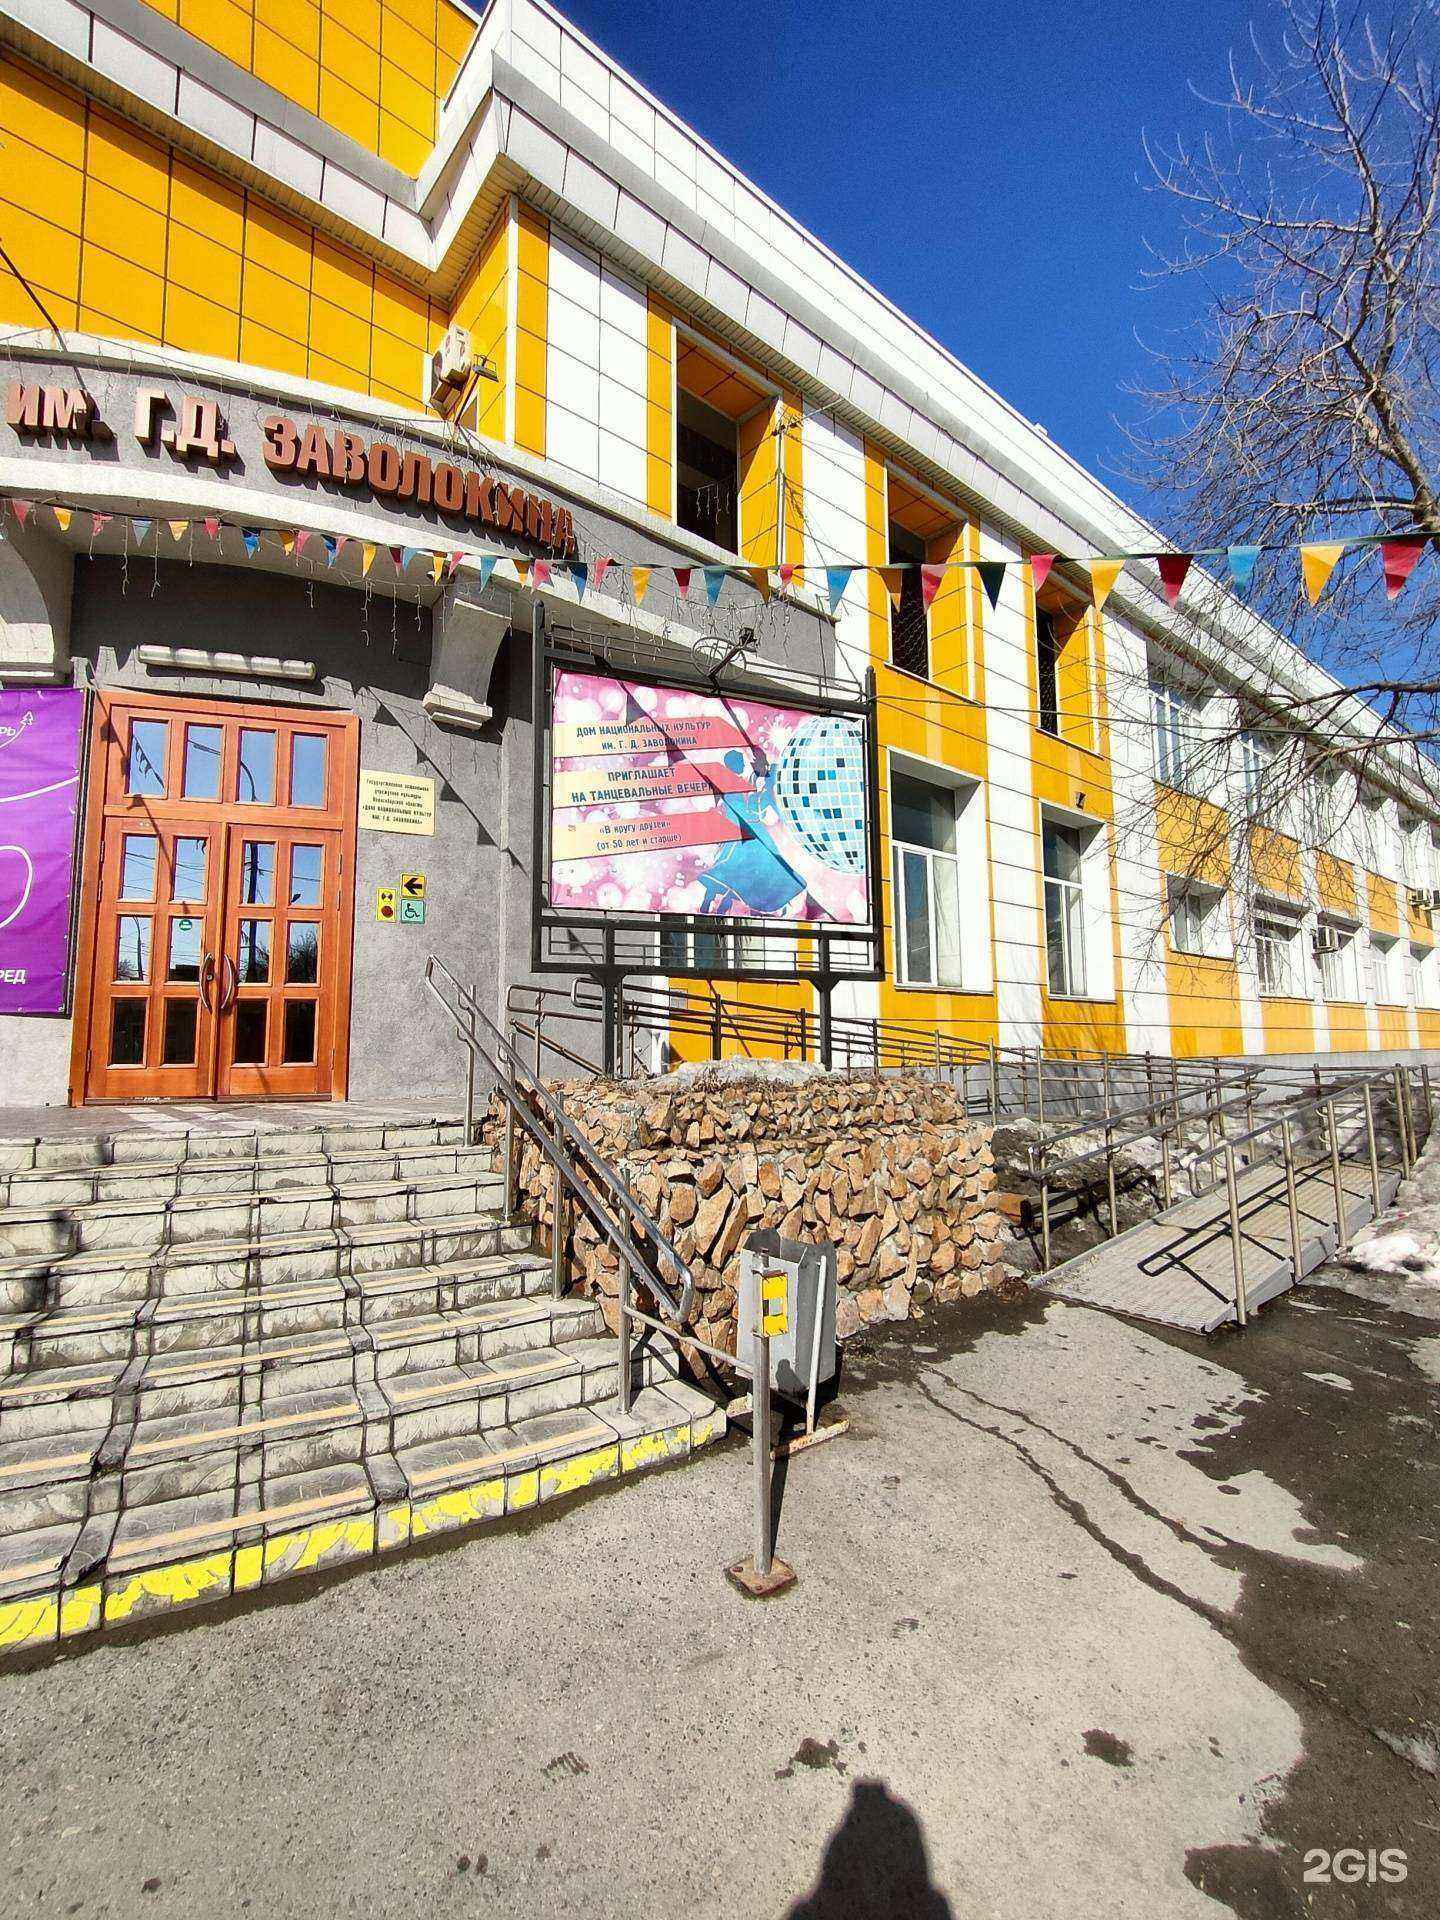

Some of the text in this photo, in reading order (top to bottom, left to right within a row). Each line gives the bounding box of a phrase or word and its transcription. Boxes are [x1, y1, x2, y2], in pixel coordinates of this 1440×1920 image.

[262, 415, 578, 555] ЗАВОЛОКИНА
[576, 721, 711, 737] ДОМ НАЦИОНАЛЬНЫХ КУЛЬТУР
[608, 767, 676, 781] ПРИГЛАШАЕТ
[571, 791, 587, 802] НА
[589, 785, 673, 801] ТАНЦЕВАЛЬНЫЕ
[614, 823, 636, 834] кругу
[596, 841, 609, 851] (от
[613, 840, 623, 848] 50
[626, 838, 640, 847] лет
[650, 833, 682, 845] старше)
